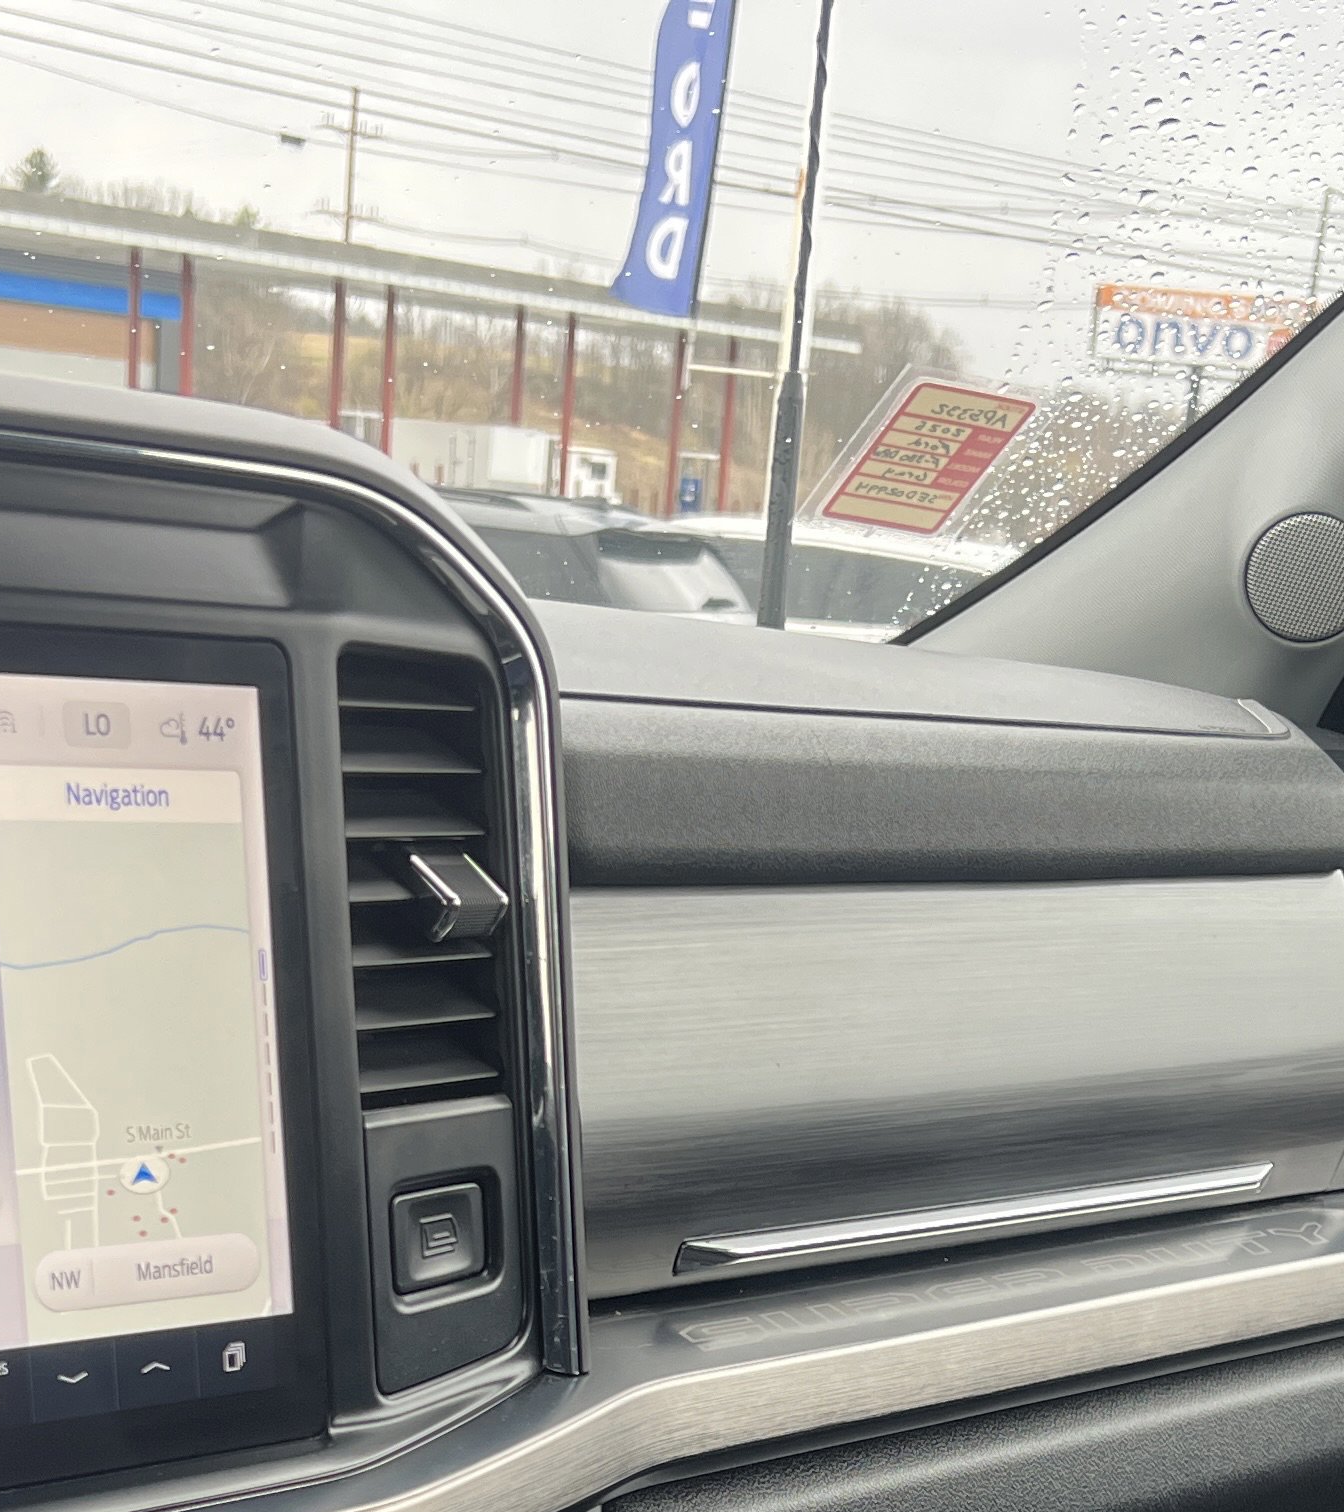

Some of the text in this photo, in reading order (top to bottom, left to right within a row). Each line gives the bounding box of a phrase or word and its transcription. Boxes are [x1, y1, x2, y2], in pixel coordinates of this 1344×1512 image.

[83, 712, 112, 737] LO
[65, 782, 171, 811] Navigation
[126, 1122, 192, 1144] S Main St
[49, 1269, 82, 1291] NW
[135, 1255, 215, 1283] Mansfield
